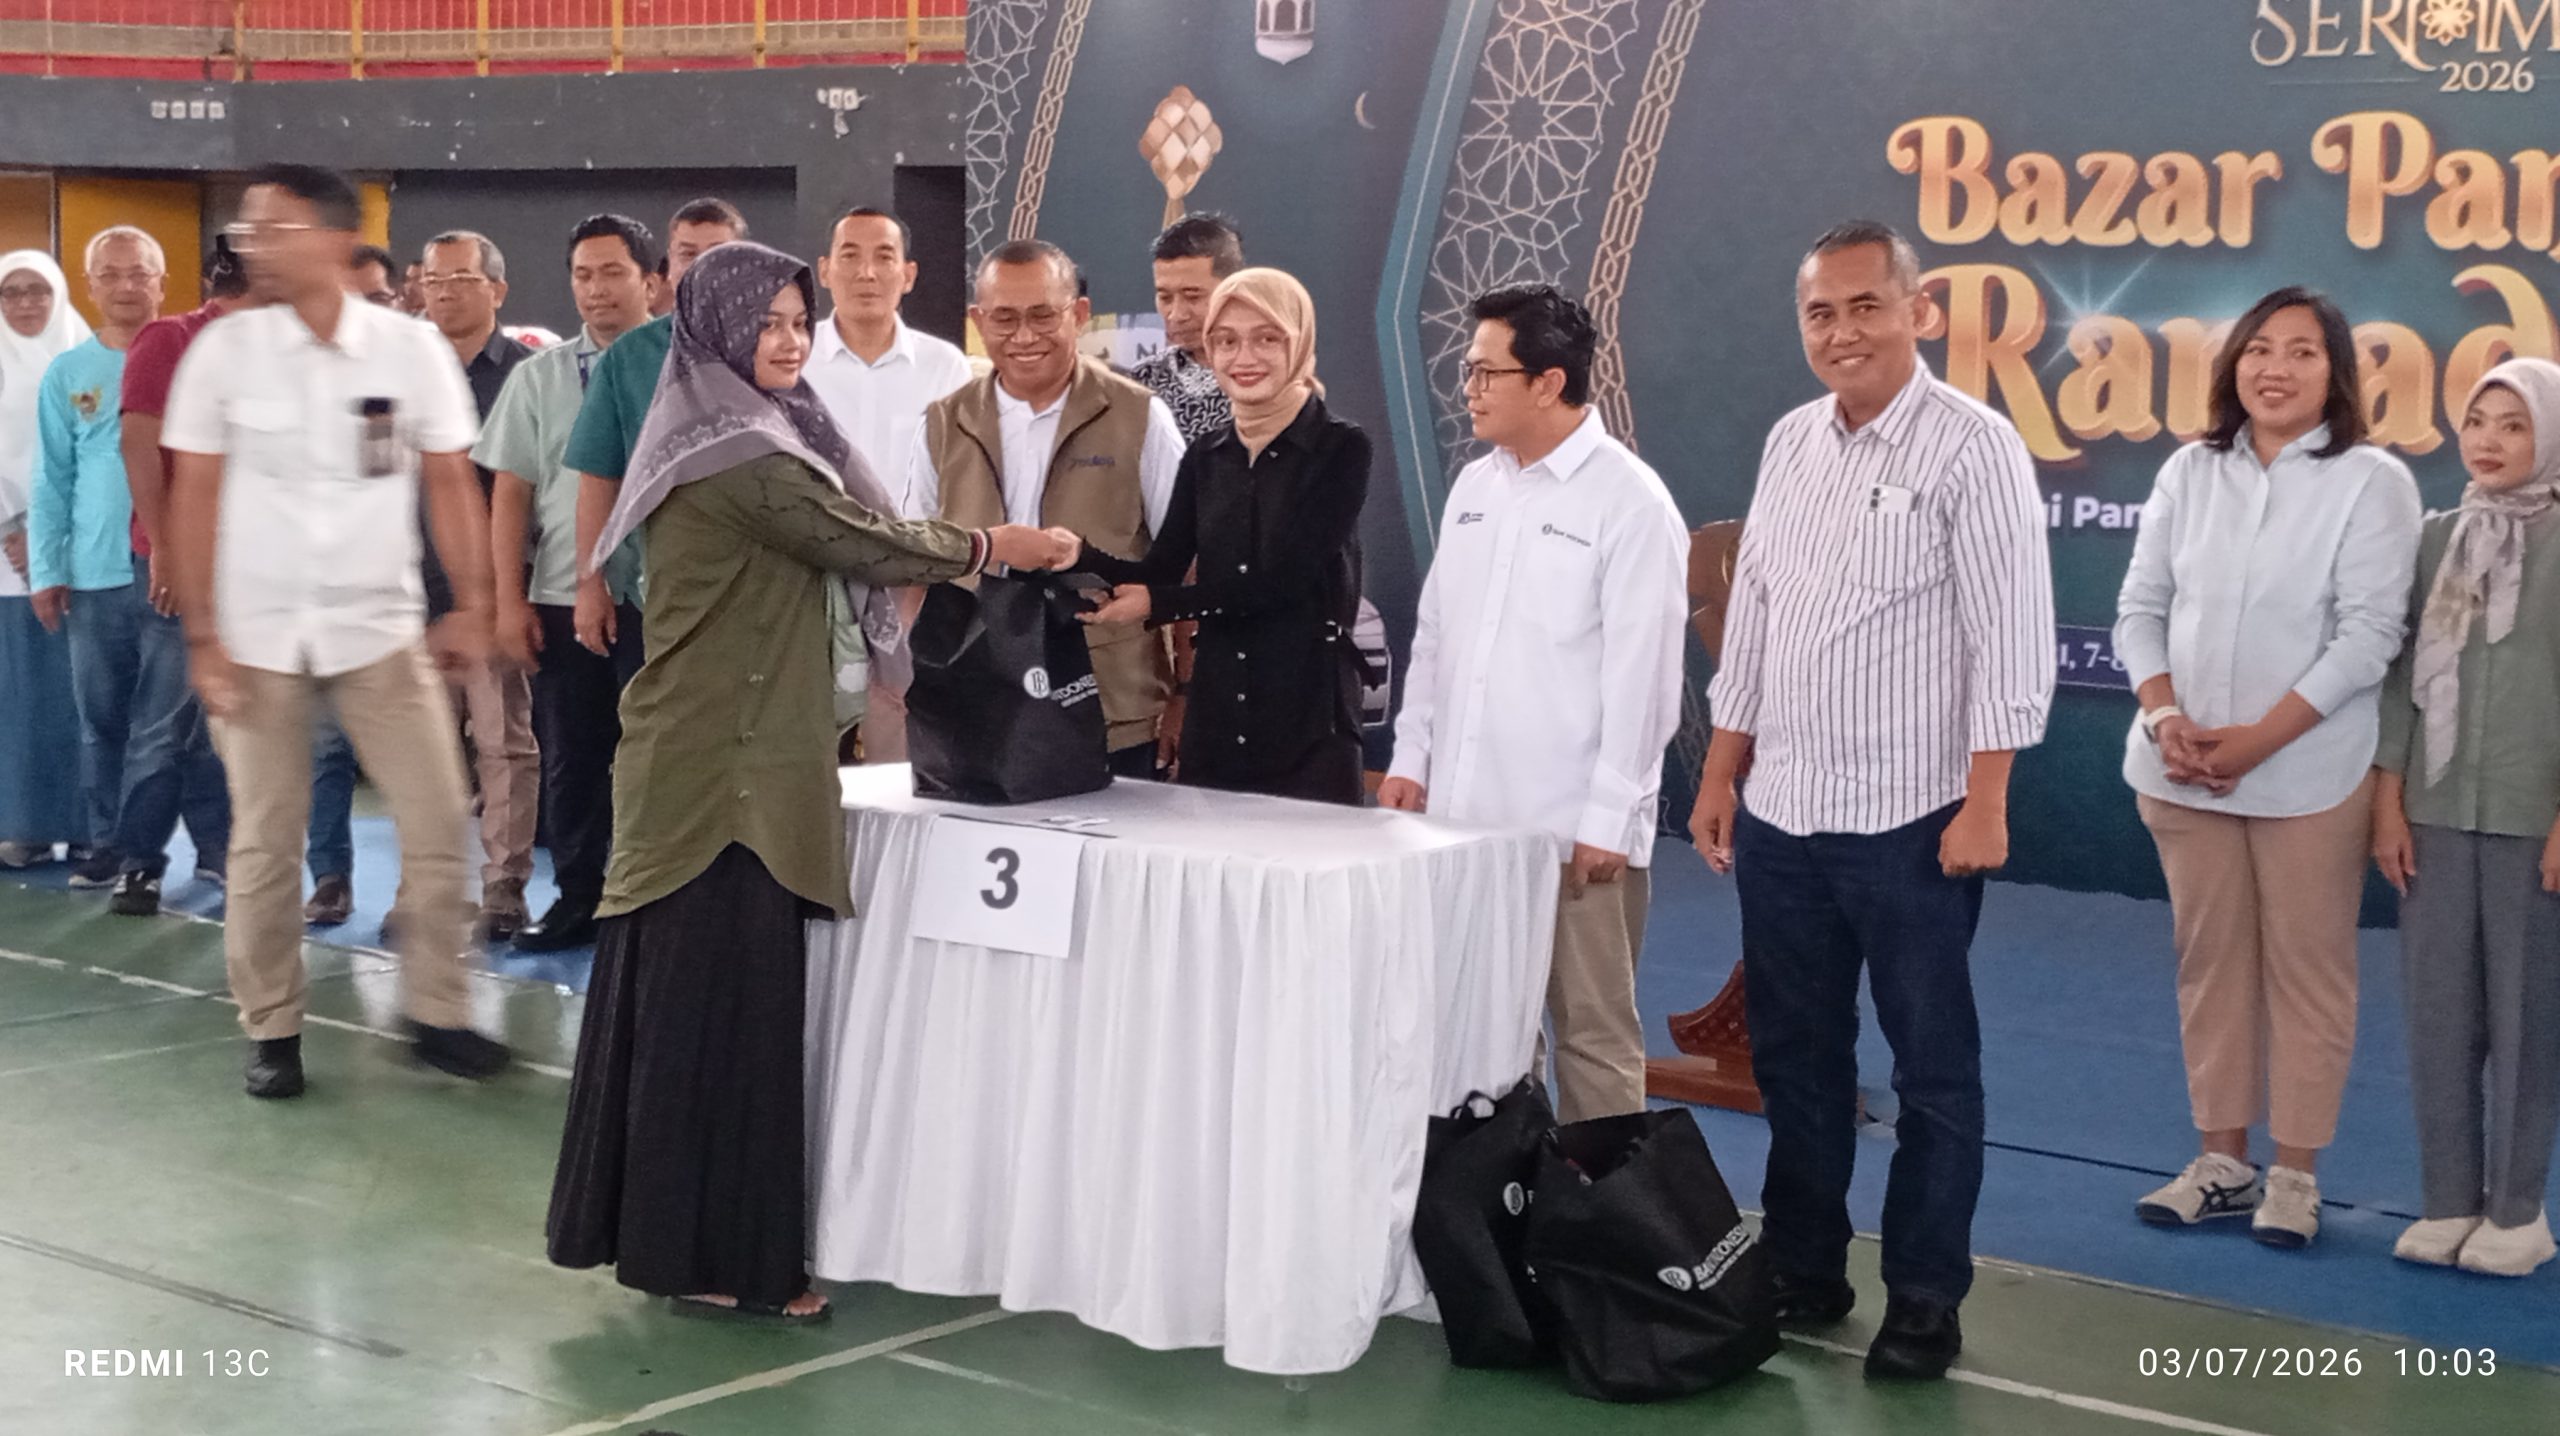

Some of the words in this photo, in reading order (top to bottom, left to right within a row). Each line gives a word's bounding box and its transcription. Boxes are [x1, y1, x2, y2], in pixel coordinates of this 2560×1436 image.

[2439, 57, 2536, 92] 2026
[1887, 115, 2283, 248] Bazar
[980, 847, 1020, 910] 3
